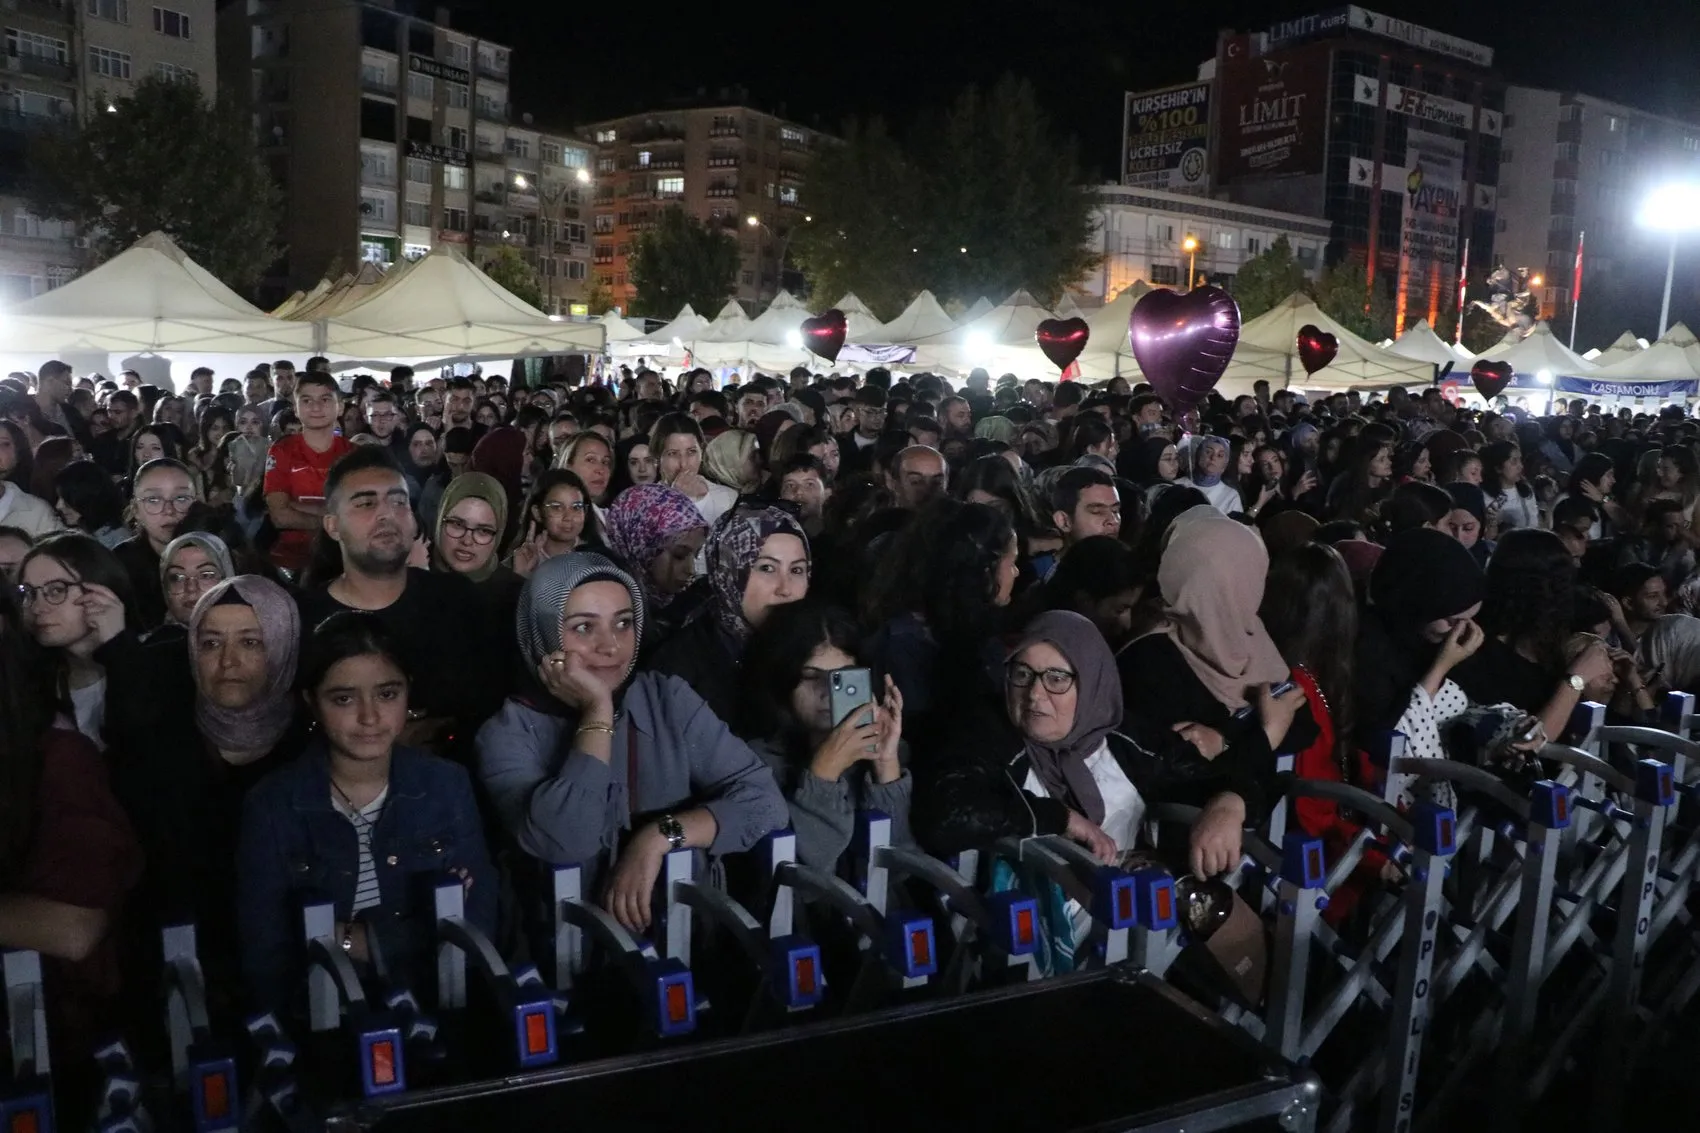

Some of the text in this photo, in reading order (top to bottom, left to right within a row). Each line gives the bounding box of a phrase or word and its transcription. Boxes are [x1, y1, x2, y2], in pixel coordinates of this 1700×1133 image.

[1320, 13, 1347, 29] KURS
[1132, 87, 1206, 114] KIRŞEHİR'İN
[1239, 90, 1307, 126] LİMİT
[1139, 106, 1198, 132] %100
[1591, 383, 1660, 395] KASTAMONU
